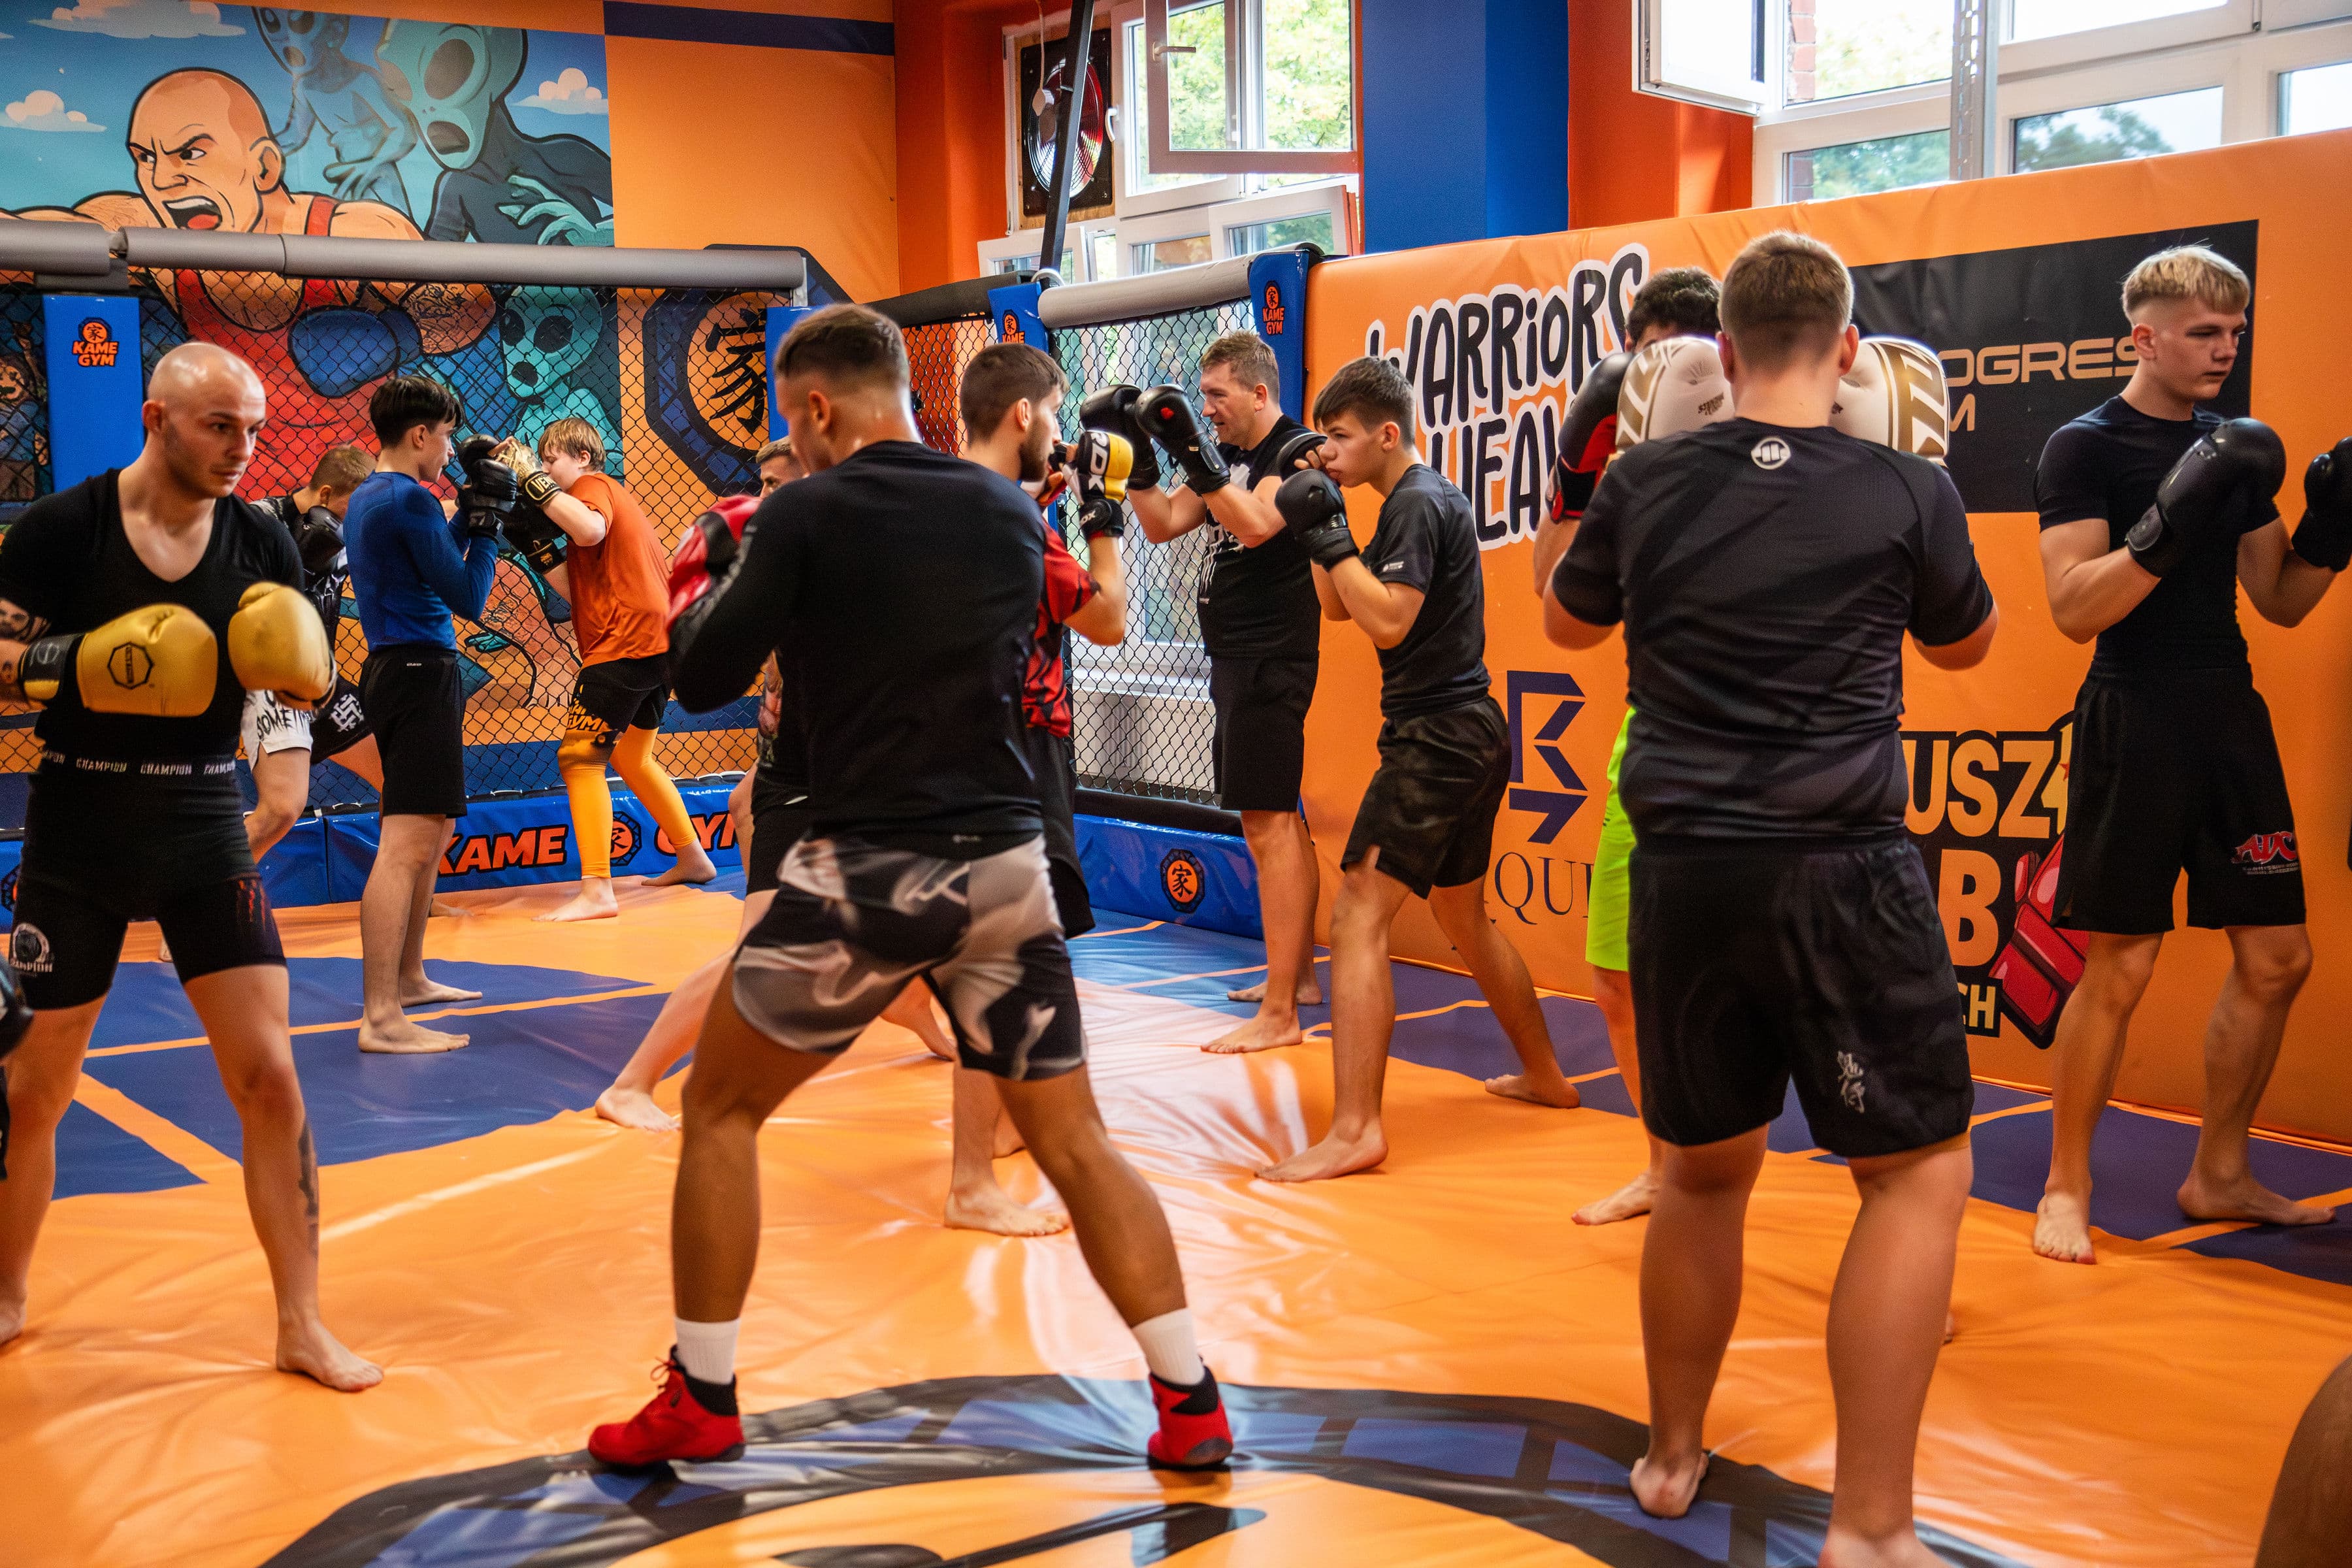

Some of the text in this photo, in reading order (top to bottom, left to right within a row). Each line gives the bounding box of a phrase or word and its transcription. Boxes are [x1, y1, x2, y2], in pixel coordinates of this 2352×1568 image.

[1262, 307, 1284, 321] KAME
[1266, 321, 1282, 335] GYM
[1002, 332, 1024, 344] KAME
[73, 340, 118, 354] KAME
[78, 353, 114, 366] GYM
[1938, 337, 2139, 387] OGRES
[76, 758, 127, 773] CHAMPION
[140, 762, 191, 775] CHAMPION
[1899, 738, 2054, 838] USZ
